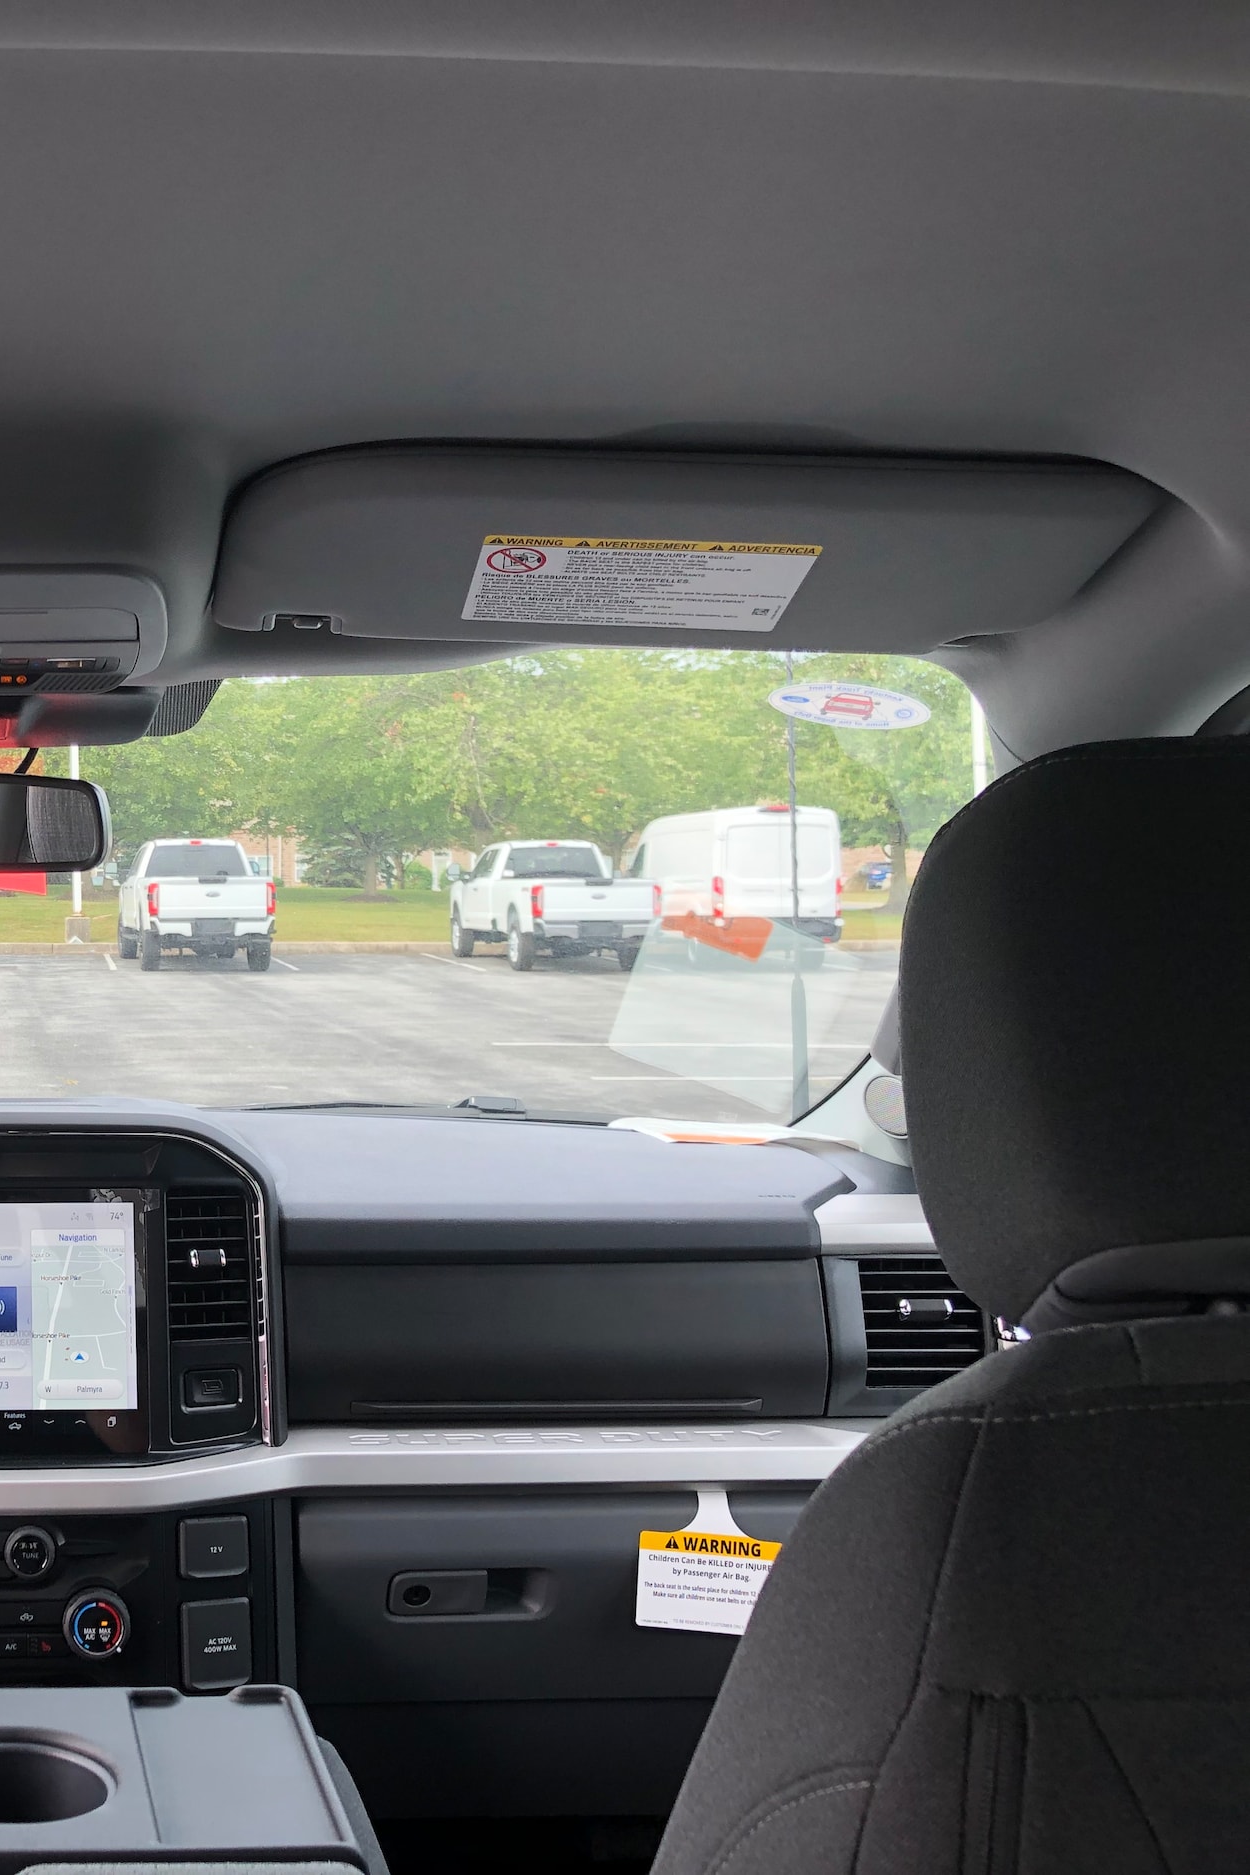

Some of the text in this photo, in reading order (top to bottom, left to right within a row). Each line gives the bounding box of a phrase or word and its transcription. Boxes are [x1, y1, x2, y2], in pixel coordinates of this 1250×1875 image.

[506, 538, 816, 554] WARNING AVERTISSEMENT ADVERTENCIA
[58, 1234, 97, 1243] Navigation
[76, 1386, 103, 1394] Palmyra
[348, 1430, 783, 1446] SUPER DUTY
[683, 1536, 761, 1557] WARNING
[648, 1554, 680, 1563] Children
[681, 1556, 696, 1564] Can
[697, 1558, 707, 1566] Be
[708, 1559, 734, 1568] KILLED
[745, 1563, 772, 1572] INJURE
[672, 1567, 681, 1576] by
[683, 1568, 721, 1580] Passenger
[722, 1571, 734, 1579] Air
[729, 1589, 749, 1597] children
[5, 1643, 18, 1651] A/C
